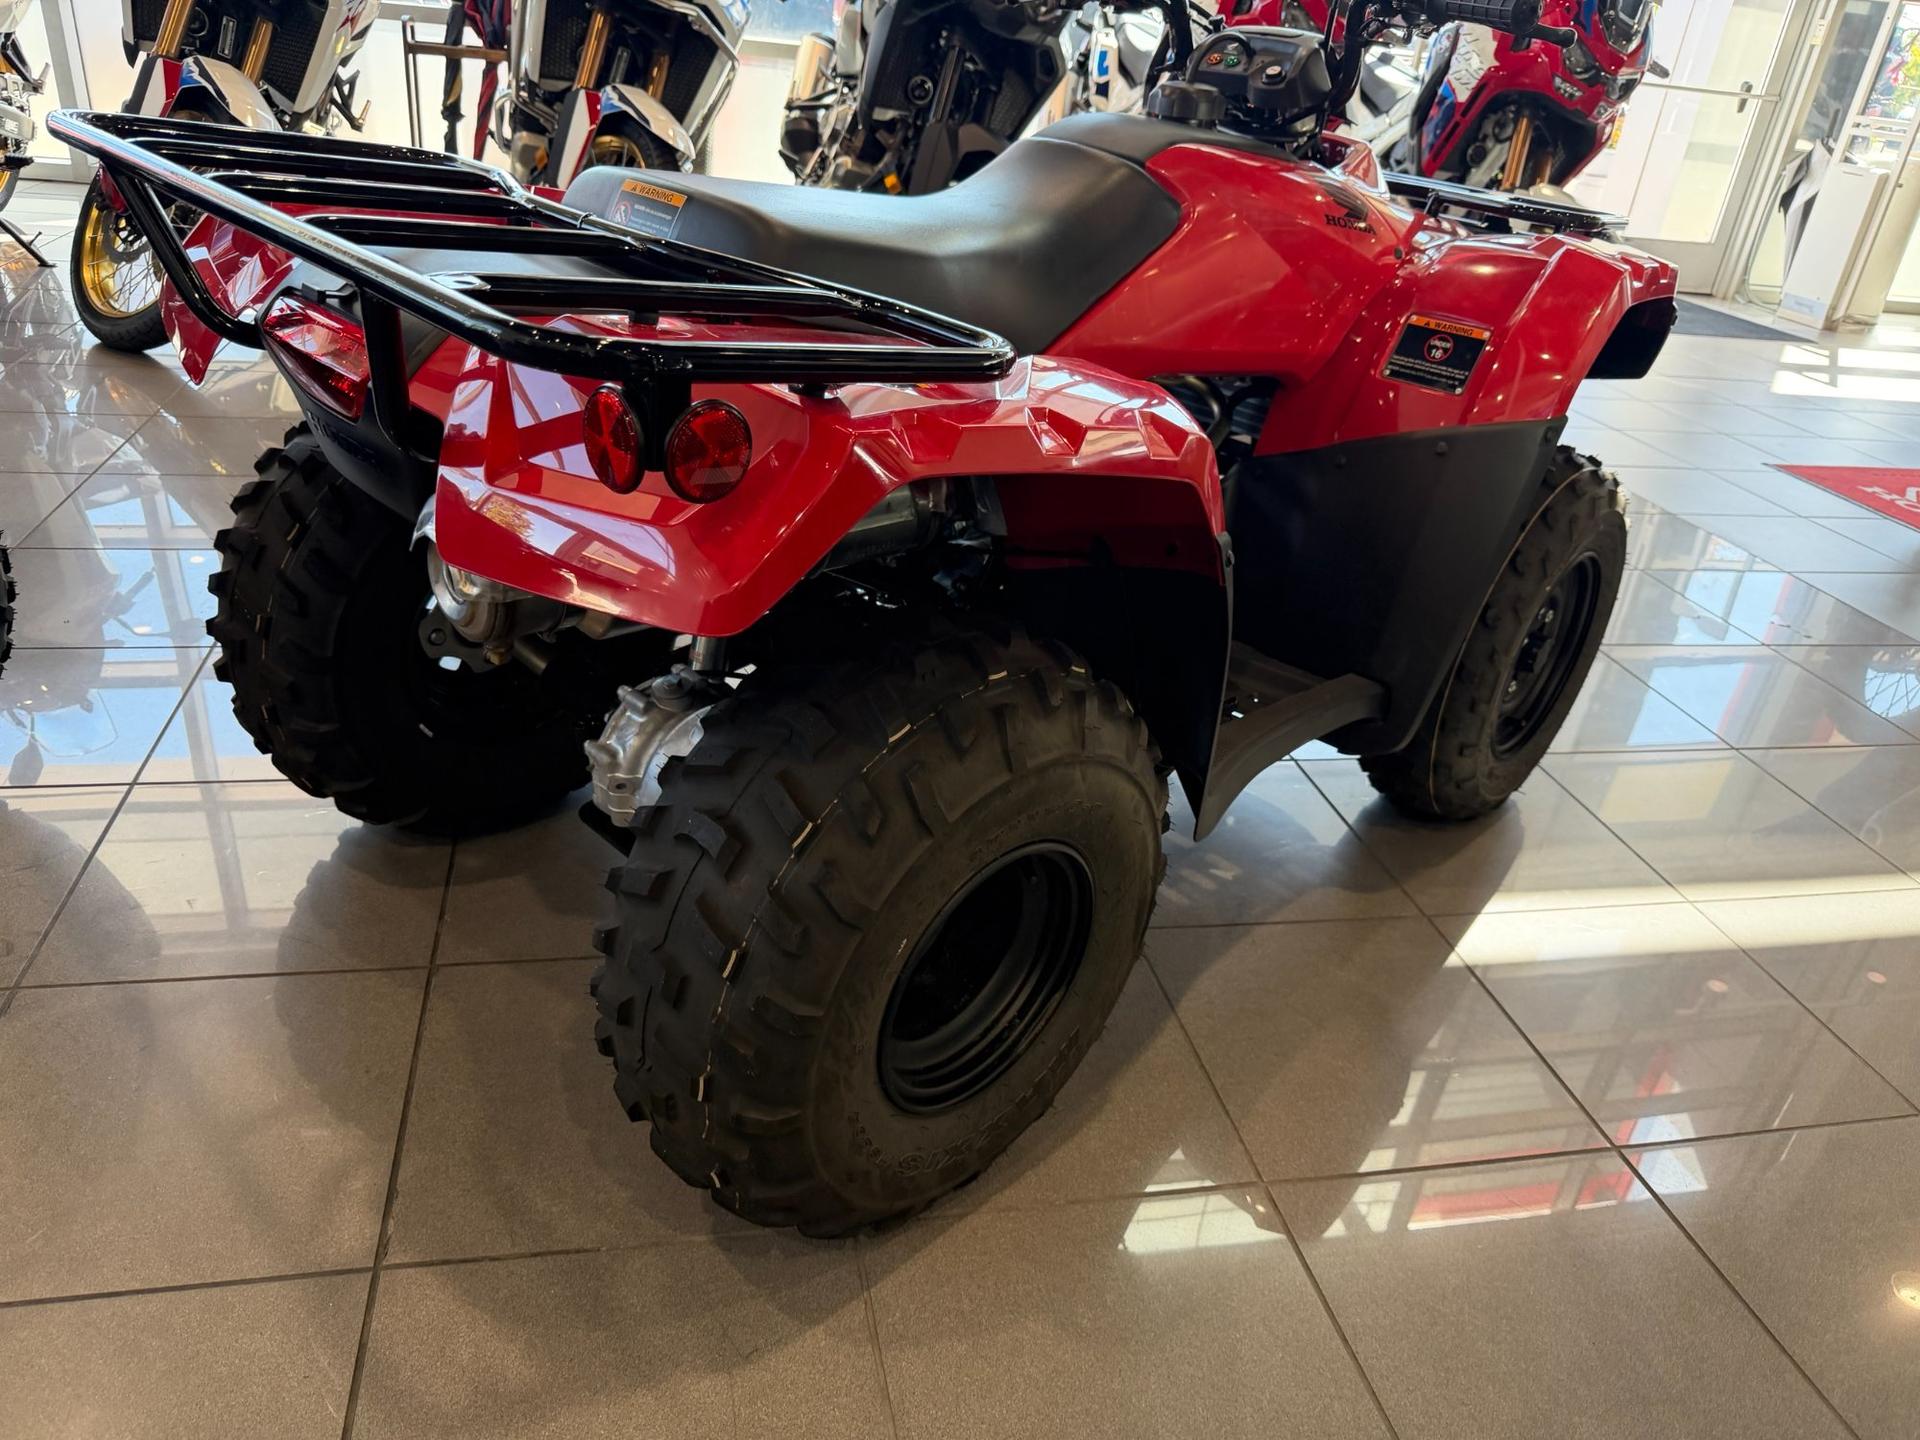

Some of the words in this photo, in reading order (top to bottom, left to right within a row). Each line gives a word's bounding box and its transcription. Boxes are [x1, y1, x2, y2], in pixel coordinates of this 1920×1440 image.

[639, 184, 674, 203] WARNING
[1434, 321, 1474, 336] WARNING
[1430, 348, 1444, 359] 16
